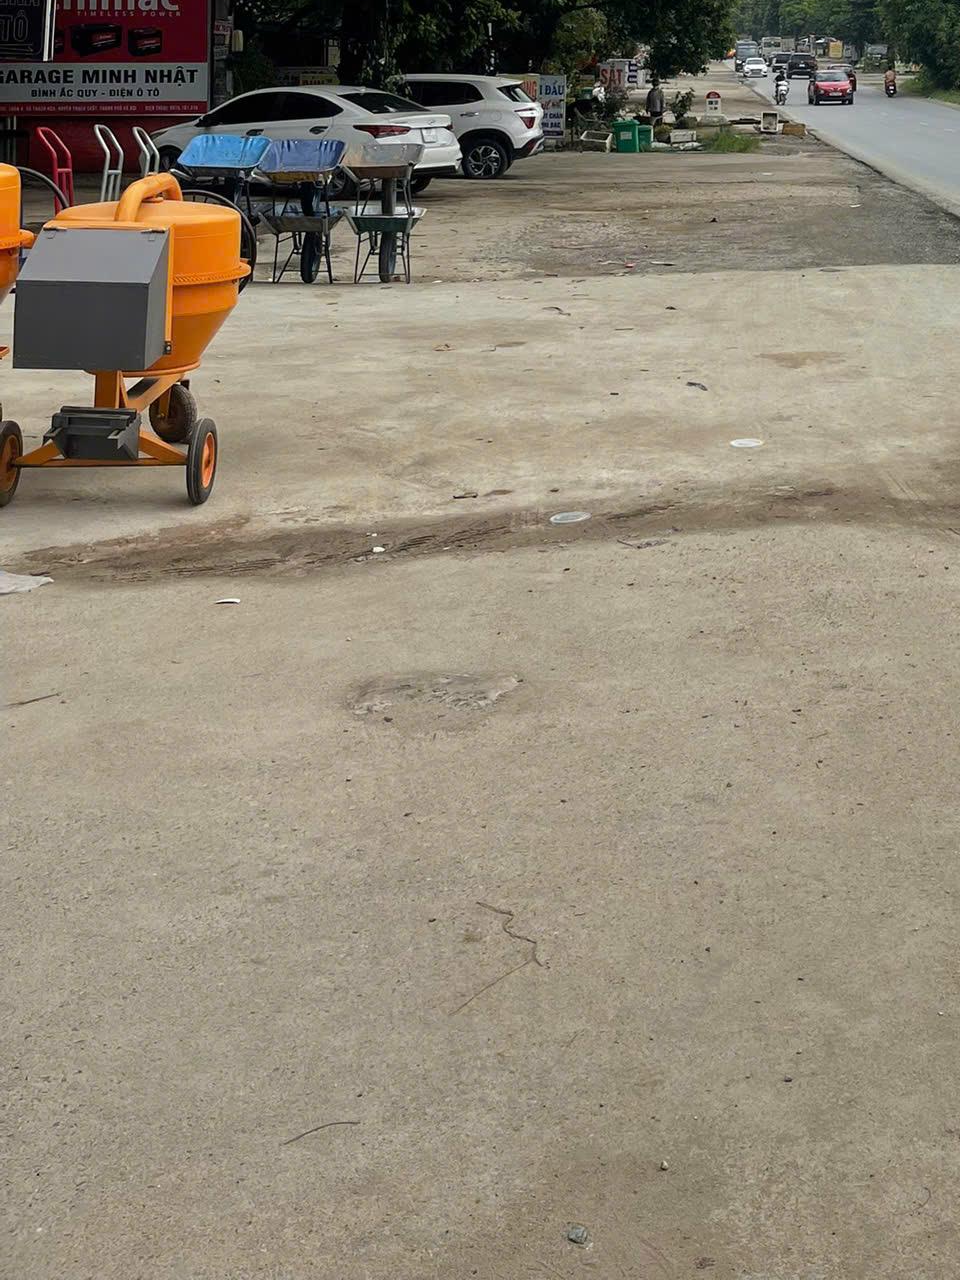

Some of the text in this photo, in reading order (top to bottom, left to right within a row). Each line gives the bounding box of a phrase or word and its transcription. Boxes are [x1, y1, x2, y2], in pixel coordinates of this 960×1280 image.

[0, 65, 198, 87] ARAGE MINH NHẬT
[31, 87, 56, 97] BÌNH
[77, 89, 98, 98] QUY
[147, 87, 160, 97] TÔ
